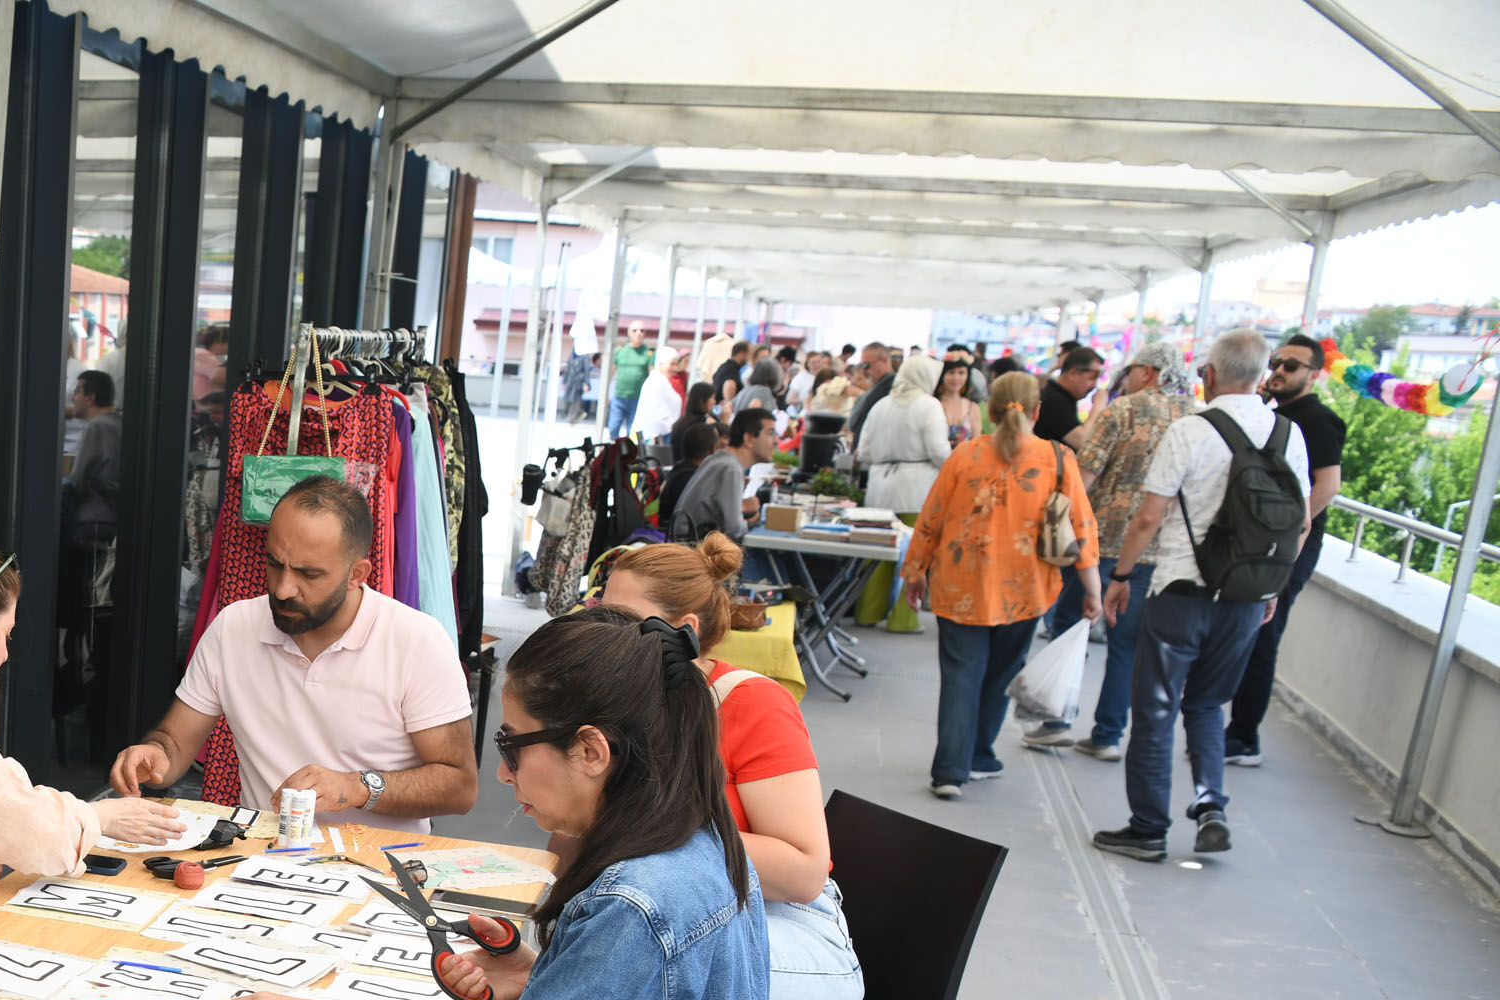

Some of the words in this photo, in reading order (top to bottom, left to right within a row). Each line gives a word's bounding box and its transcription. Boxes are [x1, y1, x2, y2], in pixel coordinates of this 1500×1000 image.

[251, 867, 350, 893] E
[23, 883, 137, 918] M
[214, 893, 317, 915] L
[167, 916, 275, 938] L
[194, 947, 306, 976] L
